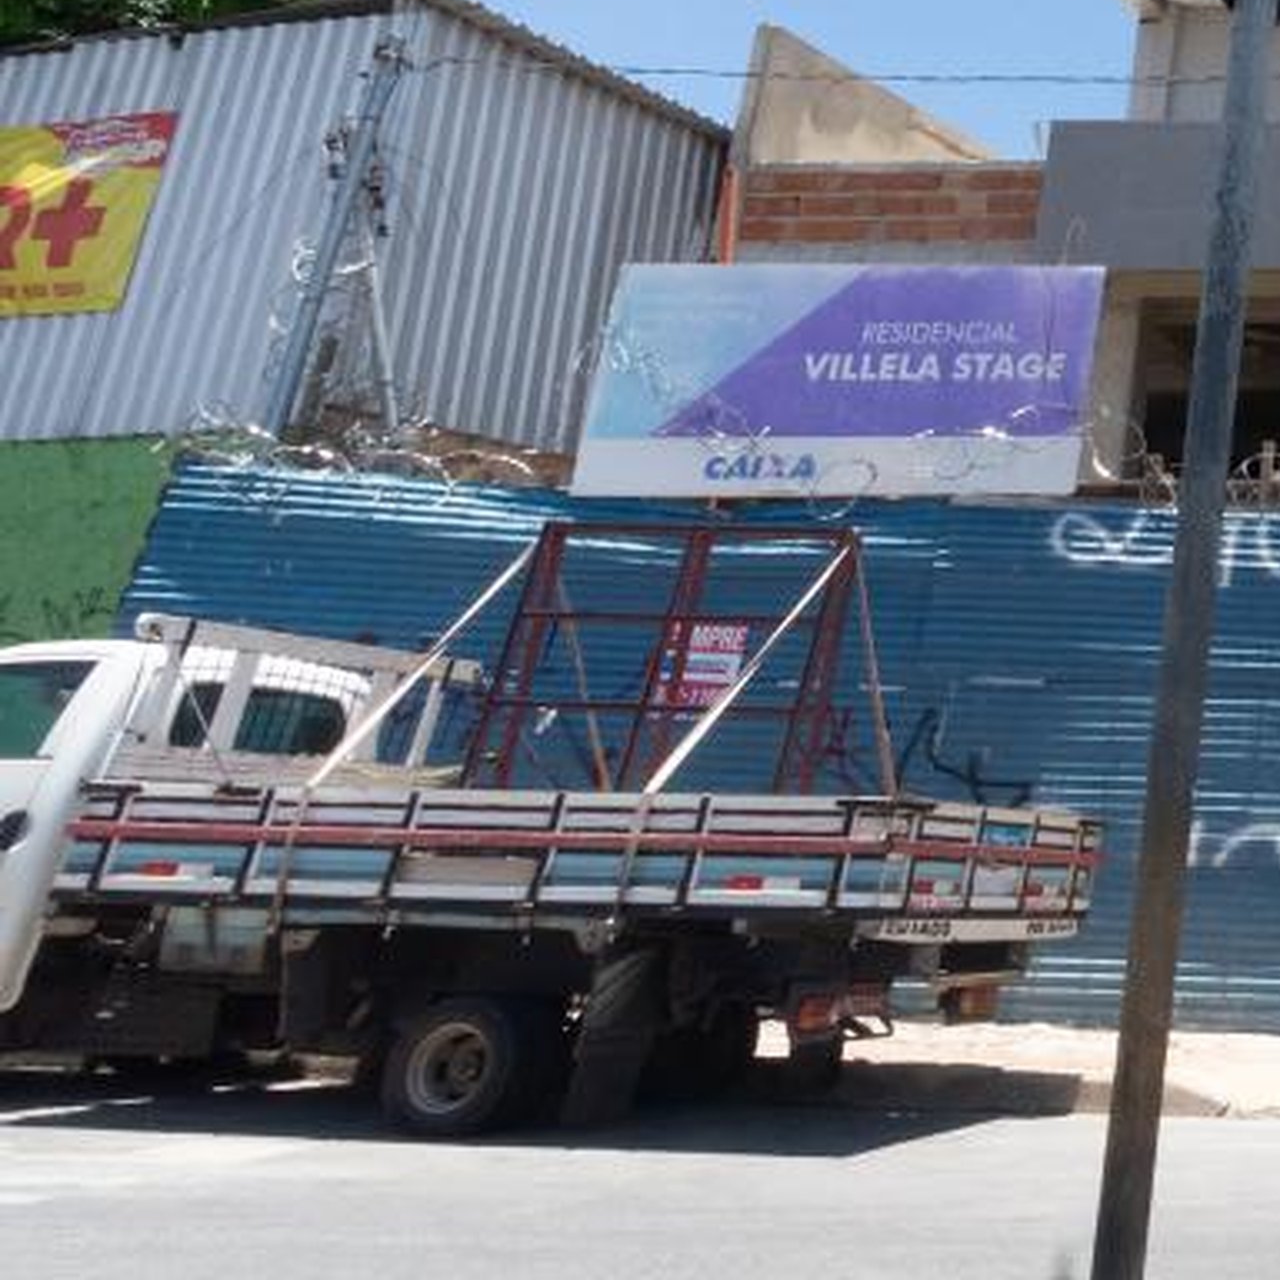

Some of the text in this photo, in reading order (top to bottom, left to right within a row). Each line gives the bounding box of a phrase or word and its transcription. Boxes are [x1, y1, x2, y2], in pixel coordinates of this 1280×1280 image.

[861, 321, 1018, 345] RESIDENCIAL
[804, 351, 1067, 382] VILLELA STAGE
[703, 453, 818, 481] CAIXA
